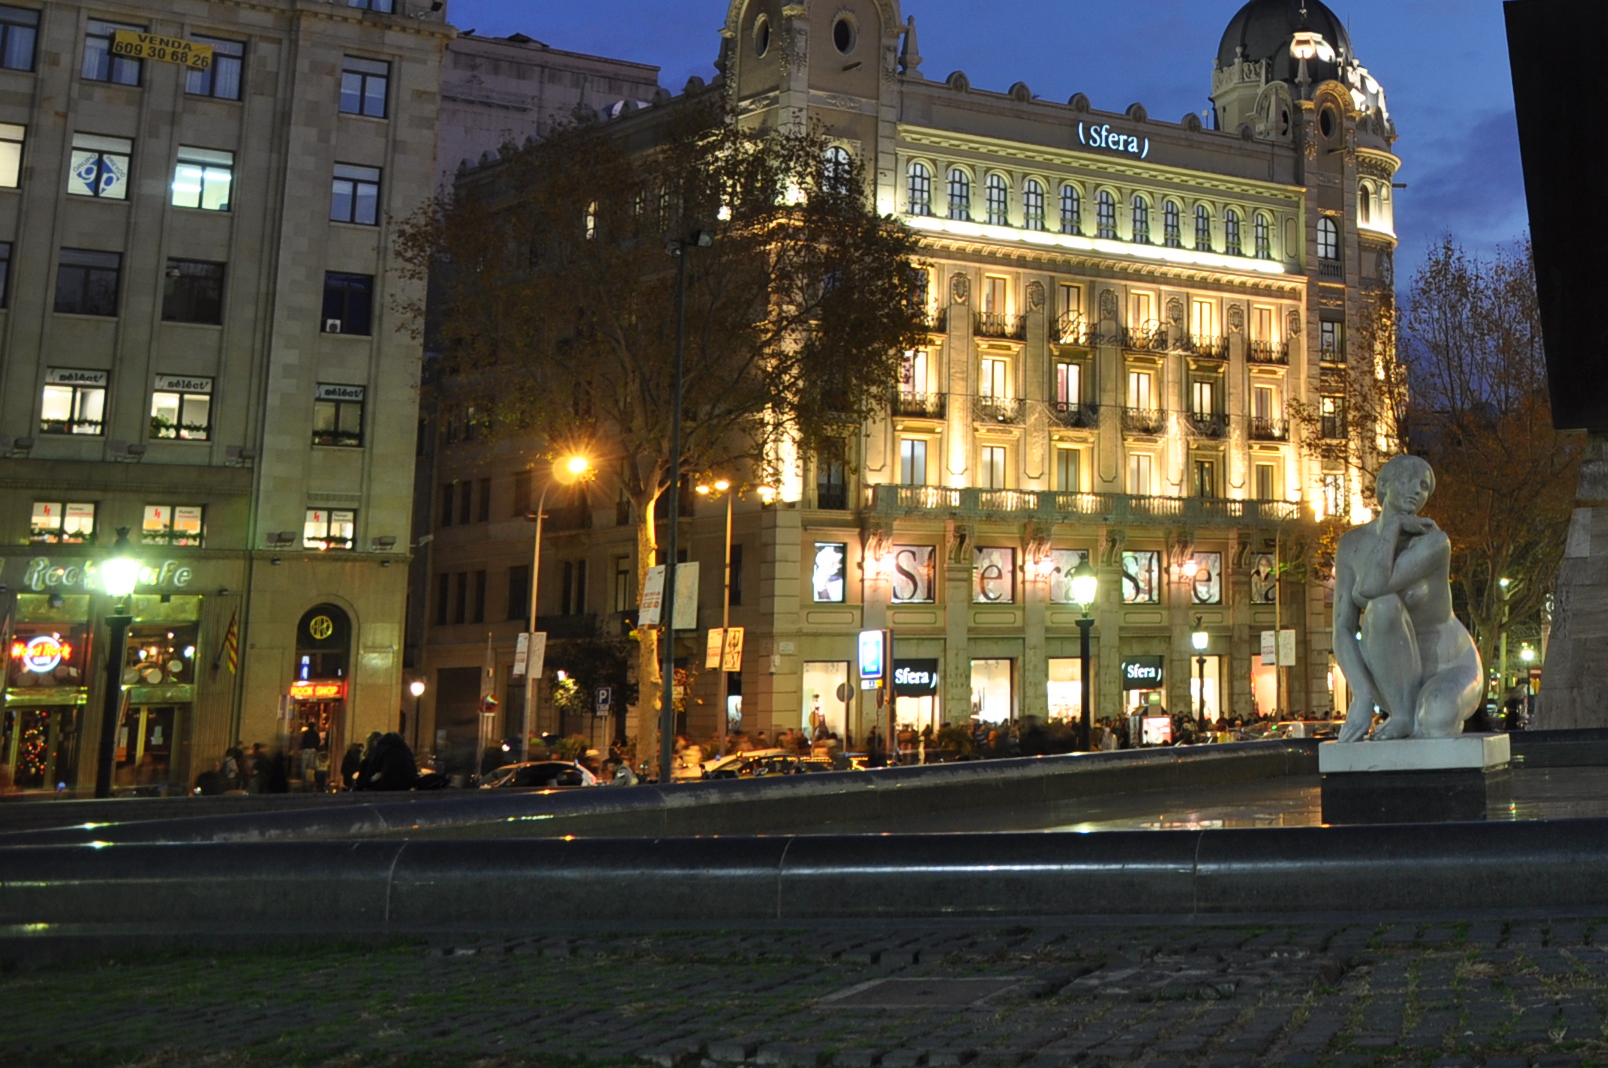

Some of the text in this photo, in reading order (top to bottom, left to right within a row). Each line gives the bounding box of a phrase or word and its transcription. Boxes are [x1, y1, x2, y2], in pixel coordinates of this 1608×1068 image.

[138, 34, 192, 52] VENDA
[115, 41, 209, 68] 609 30 68 26
